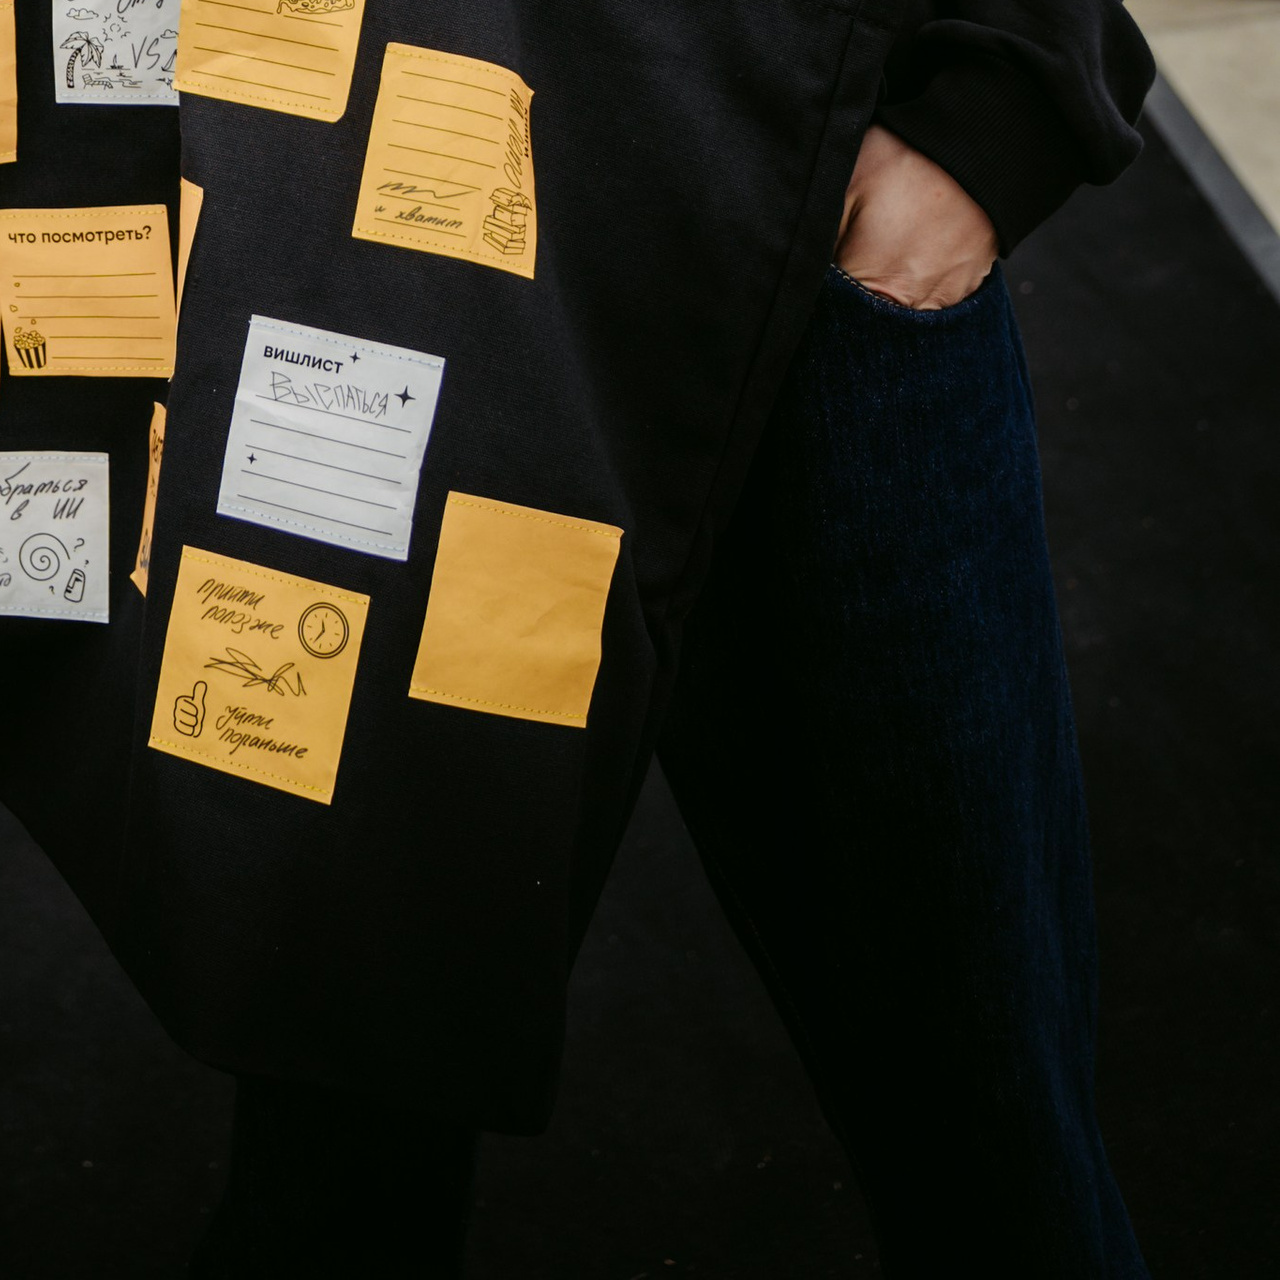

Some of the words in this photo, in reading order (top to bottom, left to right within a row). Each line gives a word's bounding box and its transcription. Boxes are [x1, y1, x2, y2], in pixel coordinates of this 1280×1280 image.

[131, 36, 161, 70] VS
[8, 231, 37, 244] что
[42, 225, 152, 245] посмотреть?
[10, 498, 30, 521] в
[52, 497, 85, 520] ИИ
[219, 727, 309, 759] пораньше
